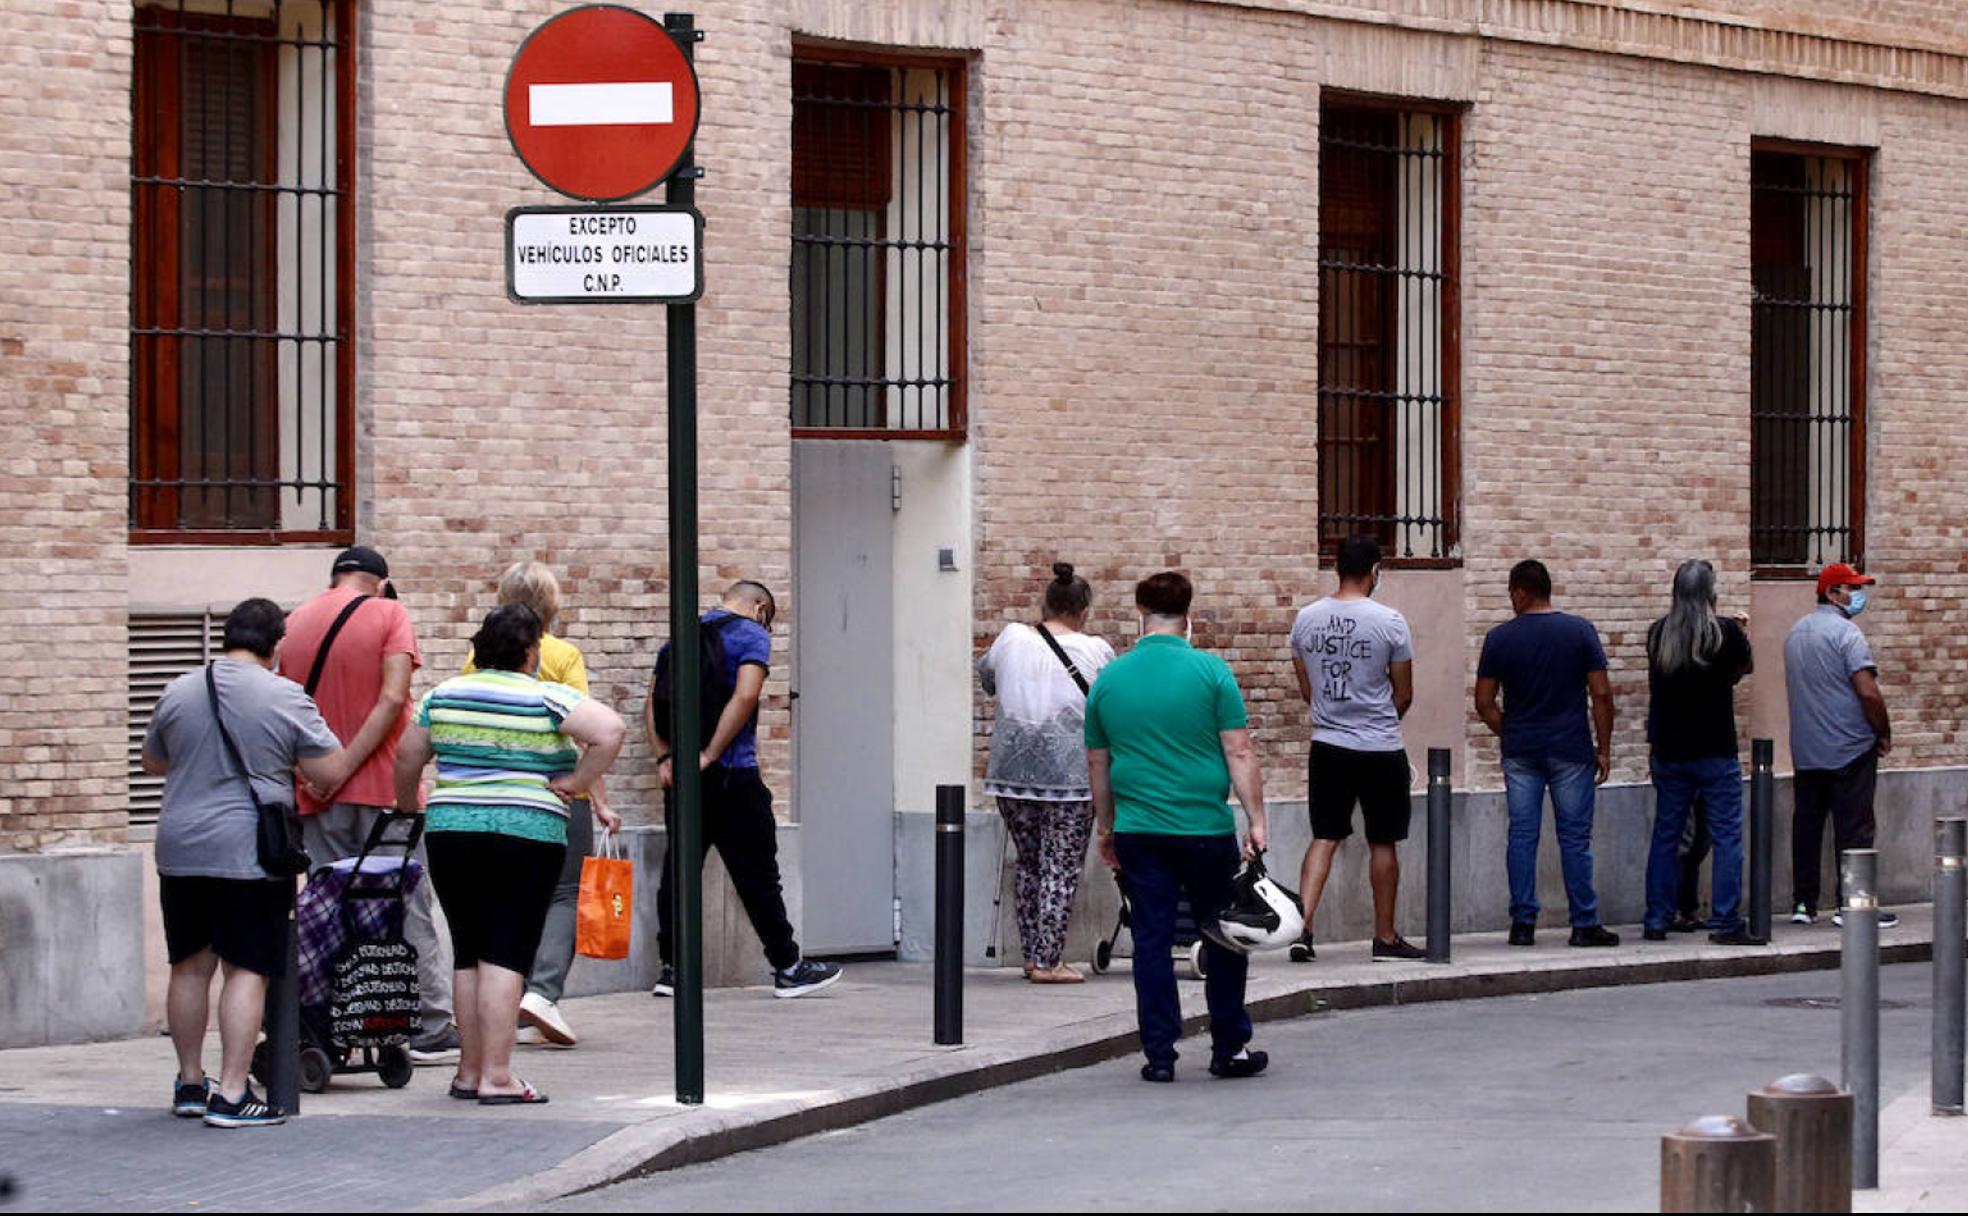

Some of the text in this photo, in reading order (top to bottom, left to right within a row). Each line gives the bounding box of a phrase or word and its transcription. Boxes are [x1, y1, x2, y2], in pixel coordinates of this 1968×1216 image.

[569, 216, 637, 235] EXCEPTO
[517, 241, 689, 264] VEHÍCULOS OFICIALES
[583, 273, 624, 292] C.N.P.
[1305, 633, 1372, 659] JUSTICE
[1321, 658, 1353, 682] FOR
[1322, 680, 1352, 701] ALL
